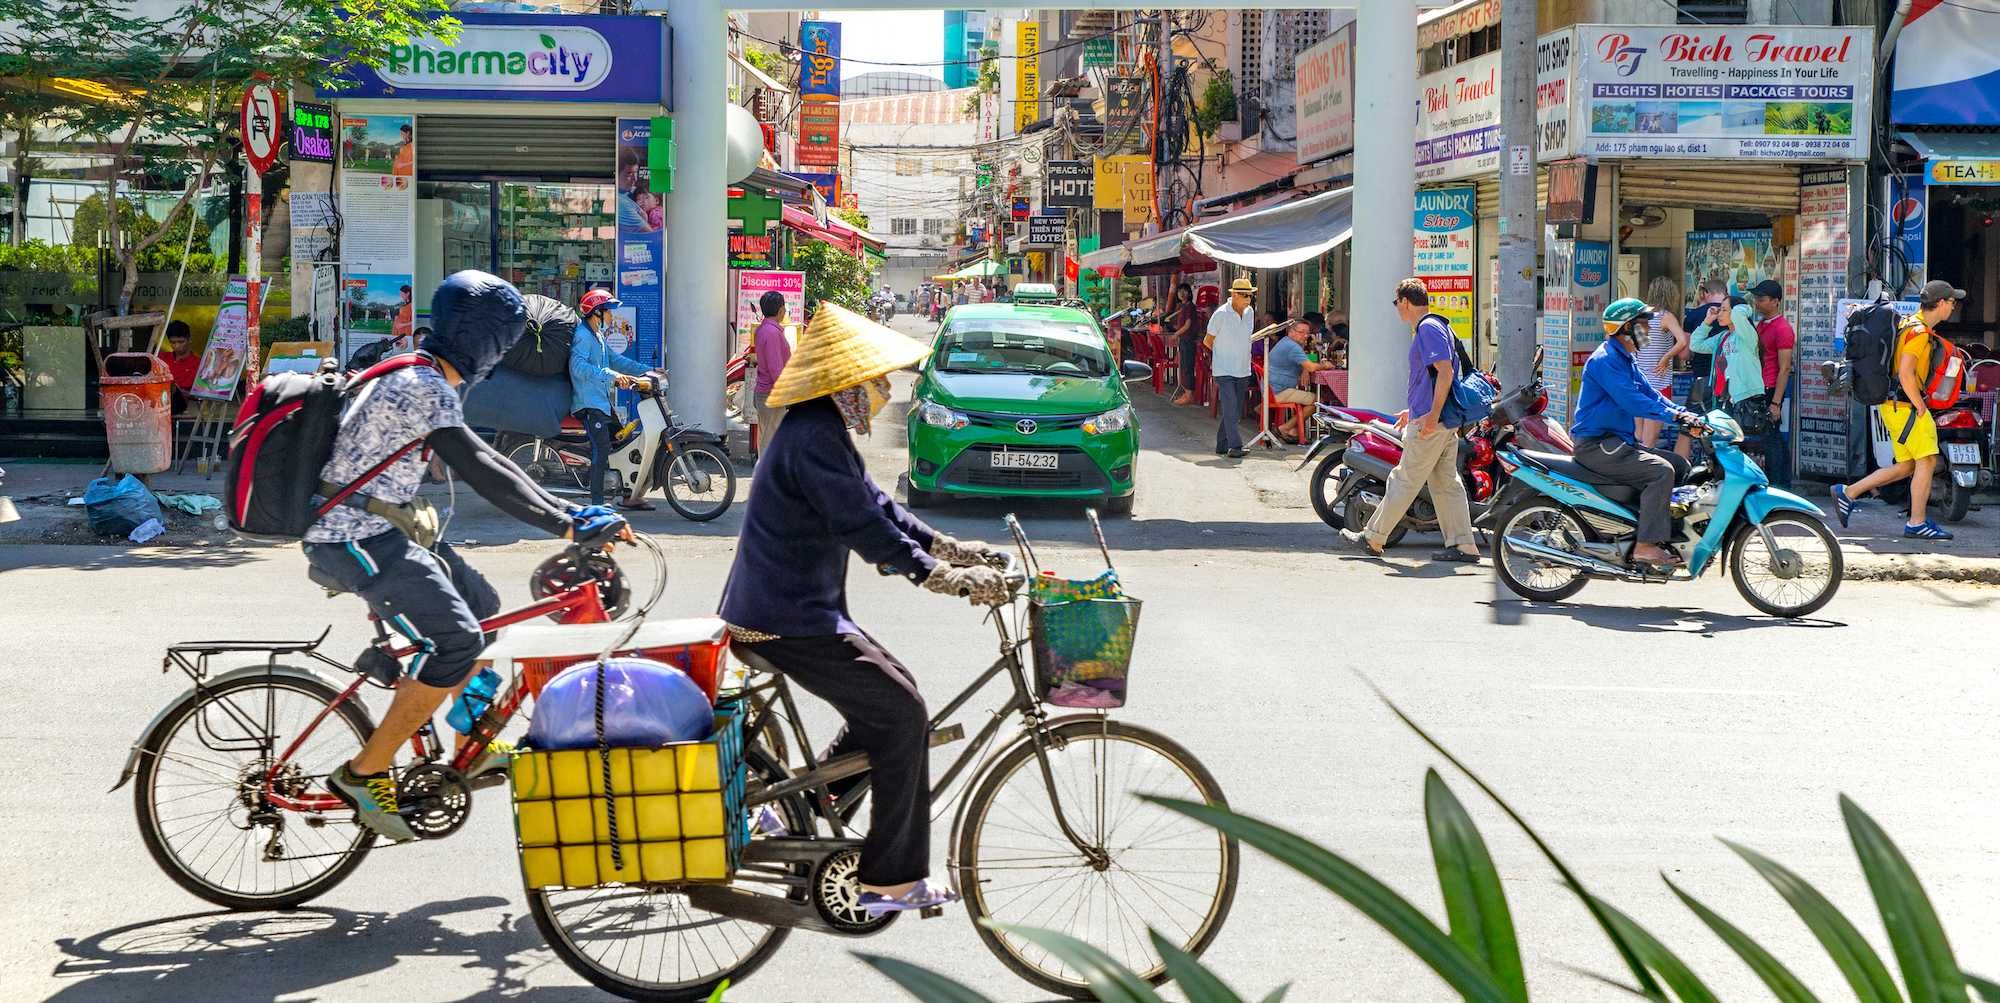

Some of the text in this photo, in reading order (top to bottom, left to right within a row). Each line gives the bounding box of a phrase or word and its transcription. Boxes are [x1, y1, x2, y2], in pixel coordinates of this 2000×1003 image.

[1484, 0, 1501, 20] Re
[1537, 36, 1569, 75] OTO SHOP
[1659, 33, 1851, 62] Bich Travel
[388, 38, 593, 83] Pharmacity
[809, 36, 836, 88] Tiger
[1671, 66, 1718, 79] Travelling
[1728, 67, 1778, 80] Happiness
[1781, 68, 1792, 78] In
[1795, 68, 1817, 78] Your
[1820, 67, 1839, 78] Life
[1456, 66, 1494, 104] Travel
[1597, 86, 1848, 98] FLIGHTS HOTELS PACKAGE TOURS
[295, 127, 331, 157] Osaka
[1545, 120, 1566, 151] SHOP
[1432, 139, 1452, 161] HOTELS
[1454, 132, 1483, 156] PACKAGE
[1596, 143, 1612, 153] Add:
[1613, 143, 1626, 152] 175
[1628, 144, 1648, 154] pham
[1649, 145, 1663, 154] ngu
[1664, 144, 1675, 153] lao
[1687, 144, 1701, 153] dist
[1739, 149, 1759, 157] Email:
[1134, 173, 1151, 185] GI
[1050, 180, 1094, 197] HOTE
[1414, 194, 1470, 212] LAUNDRY
[1424, 213, 1460, 230] Shop
[1575, 249, 1608, 266] LAUNDRY
[741, 275, 801, 289] Discount 30%
[1428, 278, 1470, 290] PASSPORT PHOTO
[137, 285, 171, 298] ragon
